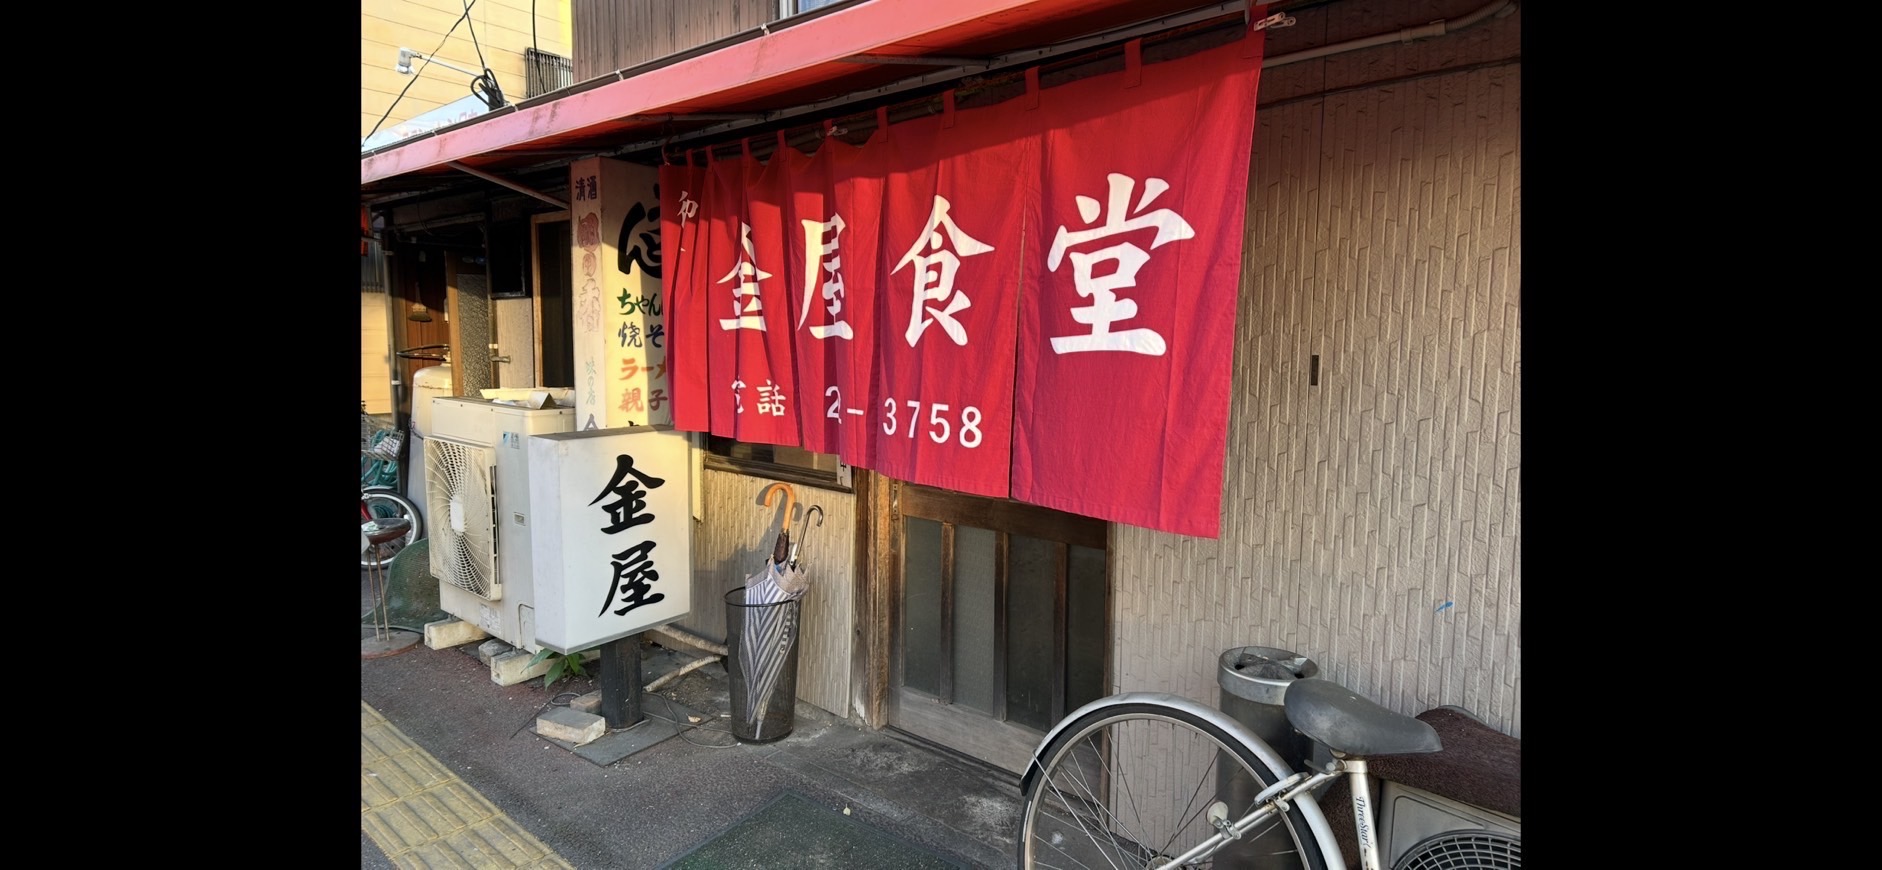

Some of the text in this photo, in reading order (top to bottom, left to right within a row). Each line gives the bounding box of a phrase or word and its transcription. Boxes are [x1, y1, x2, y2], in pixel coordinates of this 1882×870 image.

[575, 174, 598, 202] 清酒
[617, 288, 664, 316] ちゃん
[716, 172, 1196, 356] 金屋食堂
[587, 453, 666, 618] 金屋
